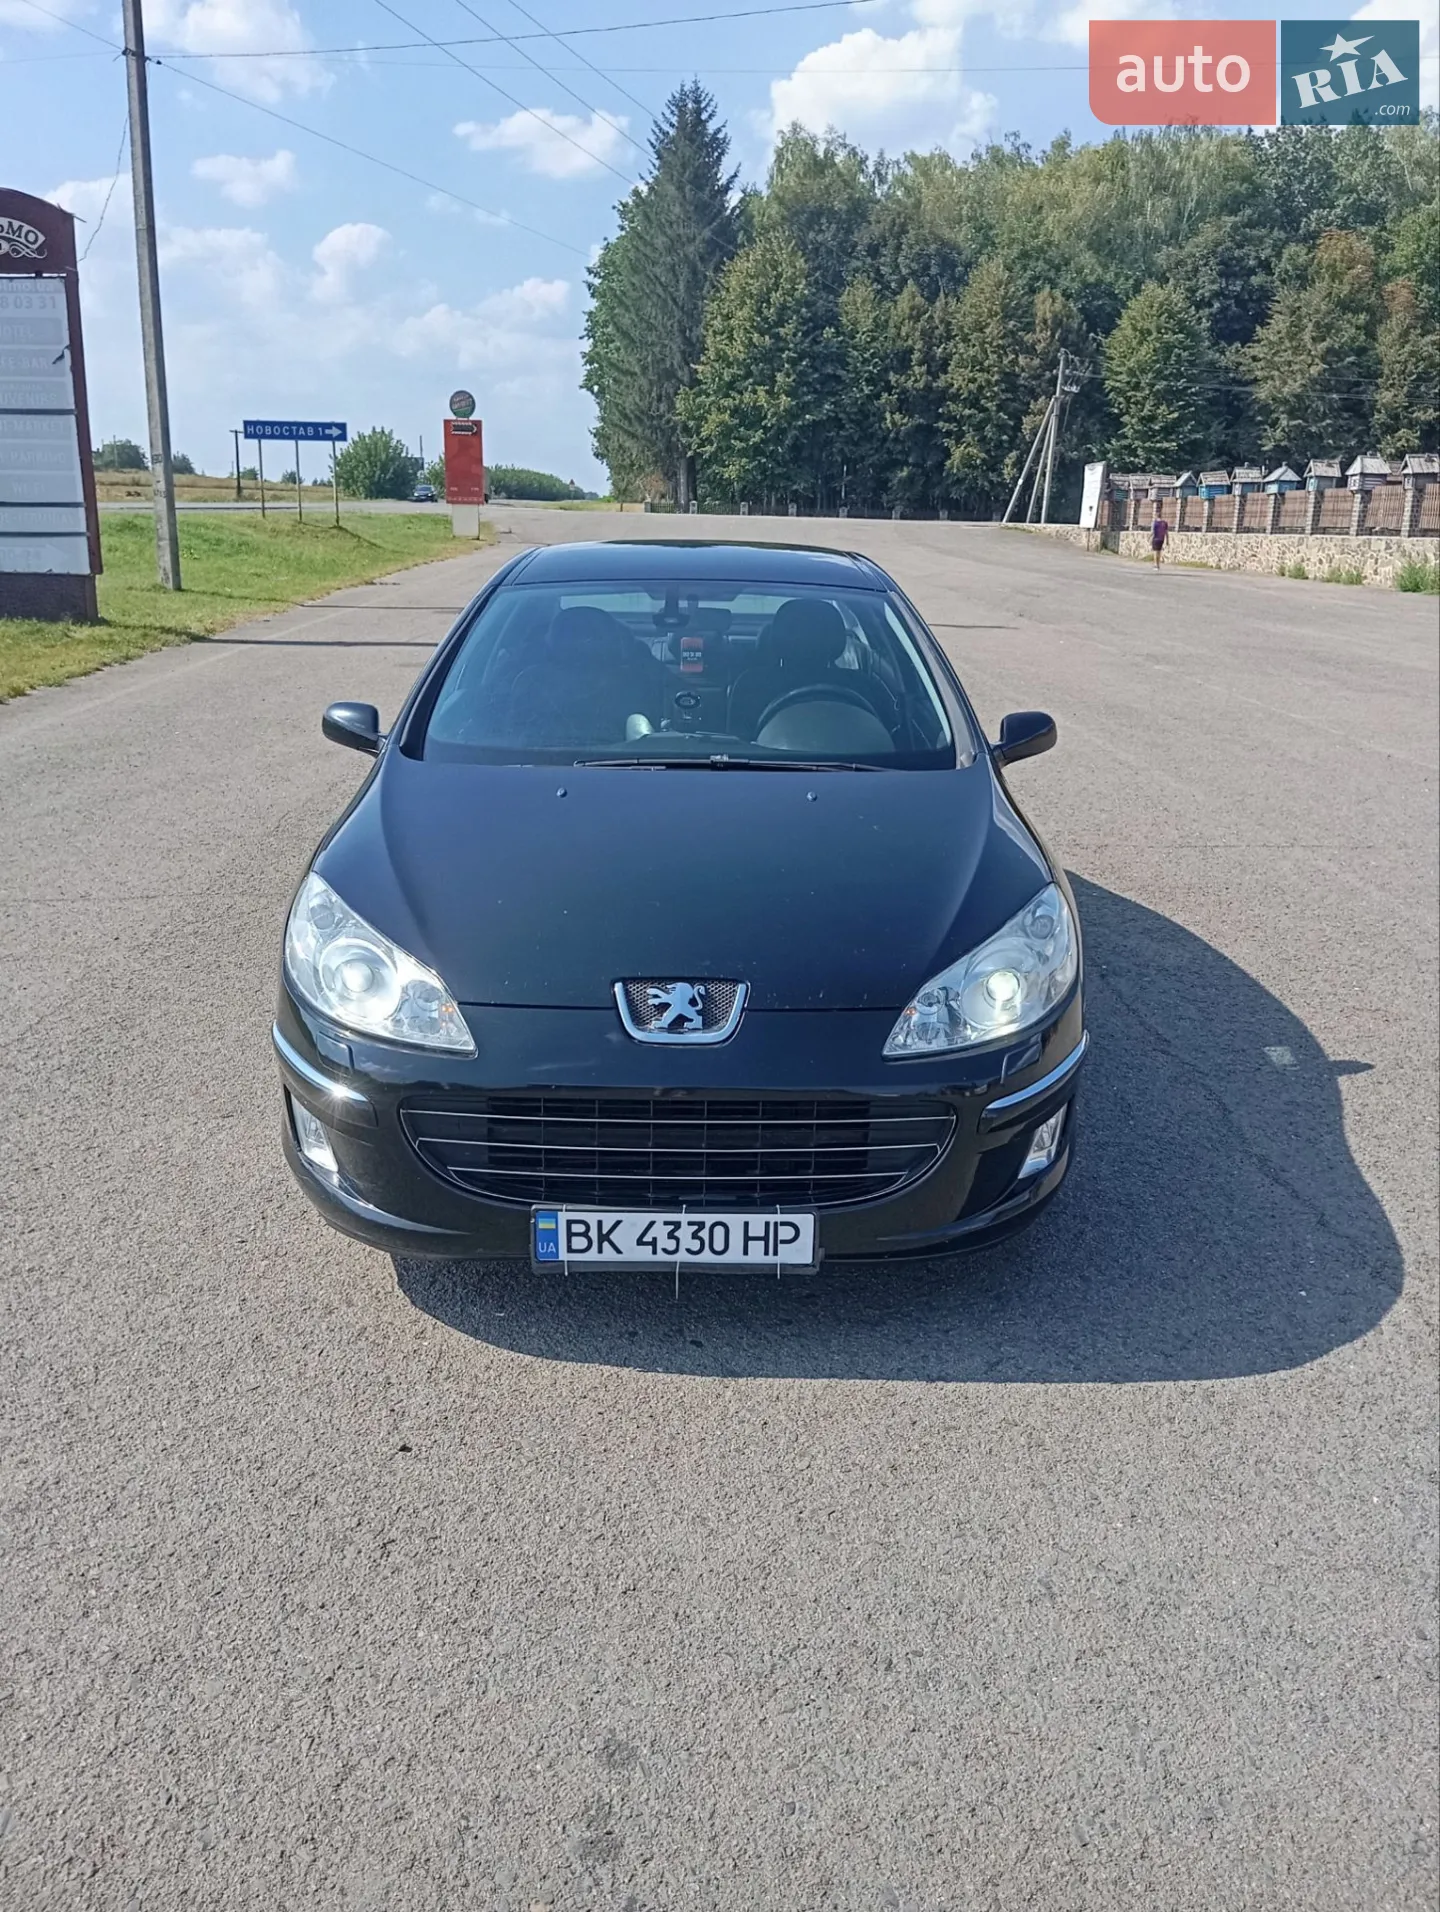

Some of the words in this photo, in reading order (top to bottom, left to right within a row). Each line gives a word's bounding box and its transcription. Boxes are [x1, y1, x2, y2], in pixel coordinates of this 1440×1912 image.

[247, 424, 315, 437] НОВОСТАВ
[565, 1218, 623, 1255] BK
[636, 1220, 730, 1256] 4330
[742, 1220, 801, 1257] HP
[538, 1242, 556, 1254] UA
